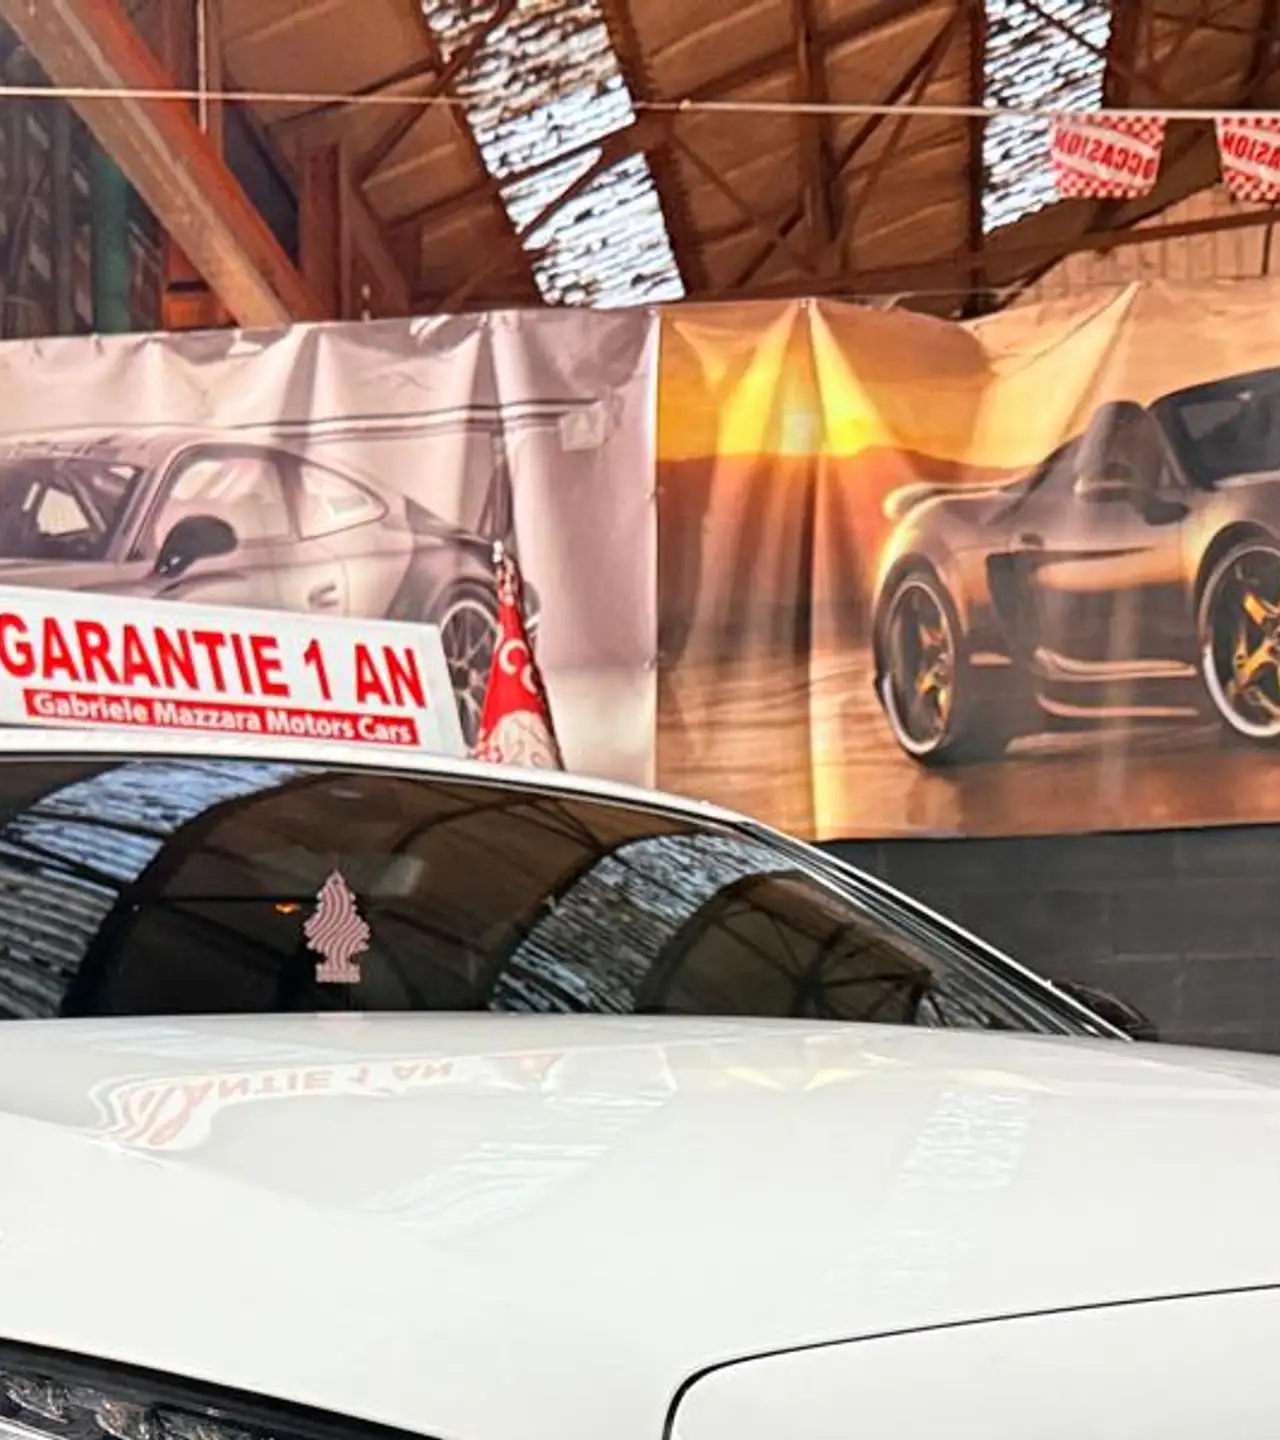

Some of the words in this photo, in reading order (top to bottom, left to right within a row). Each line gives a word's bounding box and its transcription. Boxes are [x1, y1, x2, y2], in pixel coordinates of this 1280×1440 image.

[304, 638, 332, 700] 1
[354, 642, 428, 709] AN
[33, 695, 149, 725] Gabriele
[154, 705, 261, 732] Mazzara
[267, 713, 355, 739] Motors
[359, 717, 412, 744] Cars
